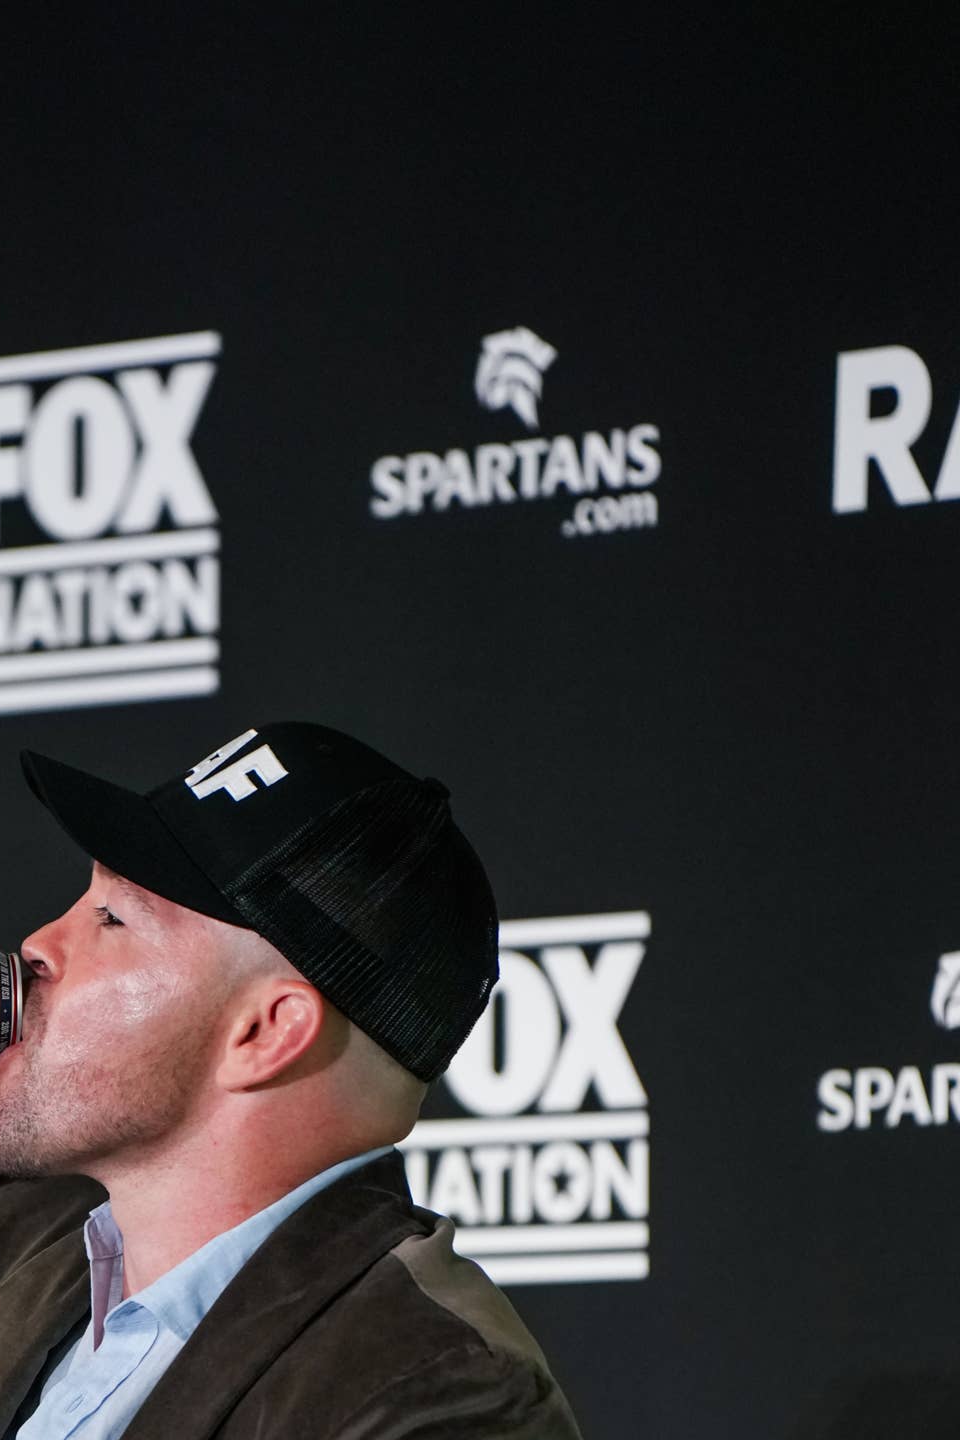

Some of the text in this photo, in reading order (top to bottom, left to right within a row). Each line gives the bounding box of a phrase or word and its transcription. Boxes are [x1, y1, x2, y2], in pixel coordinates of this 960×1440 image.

[370, 423, 662, 519] SPARTANS
[561, 490, 659, 538] .com
[442, 940, 648, 1118] OX
